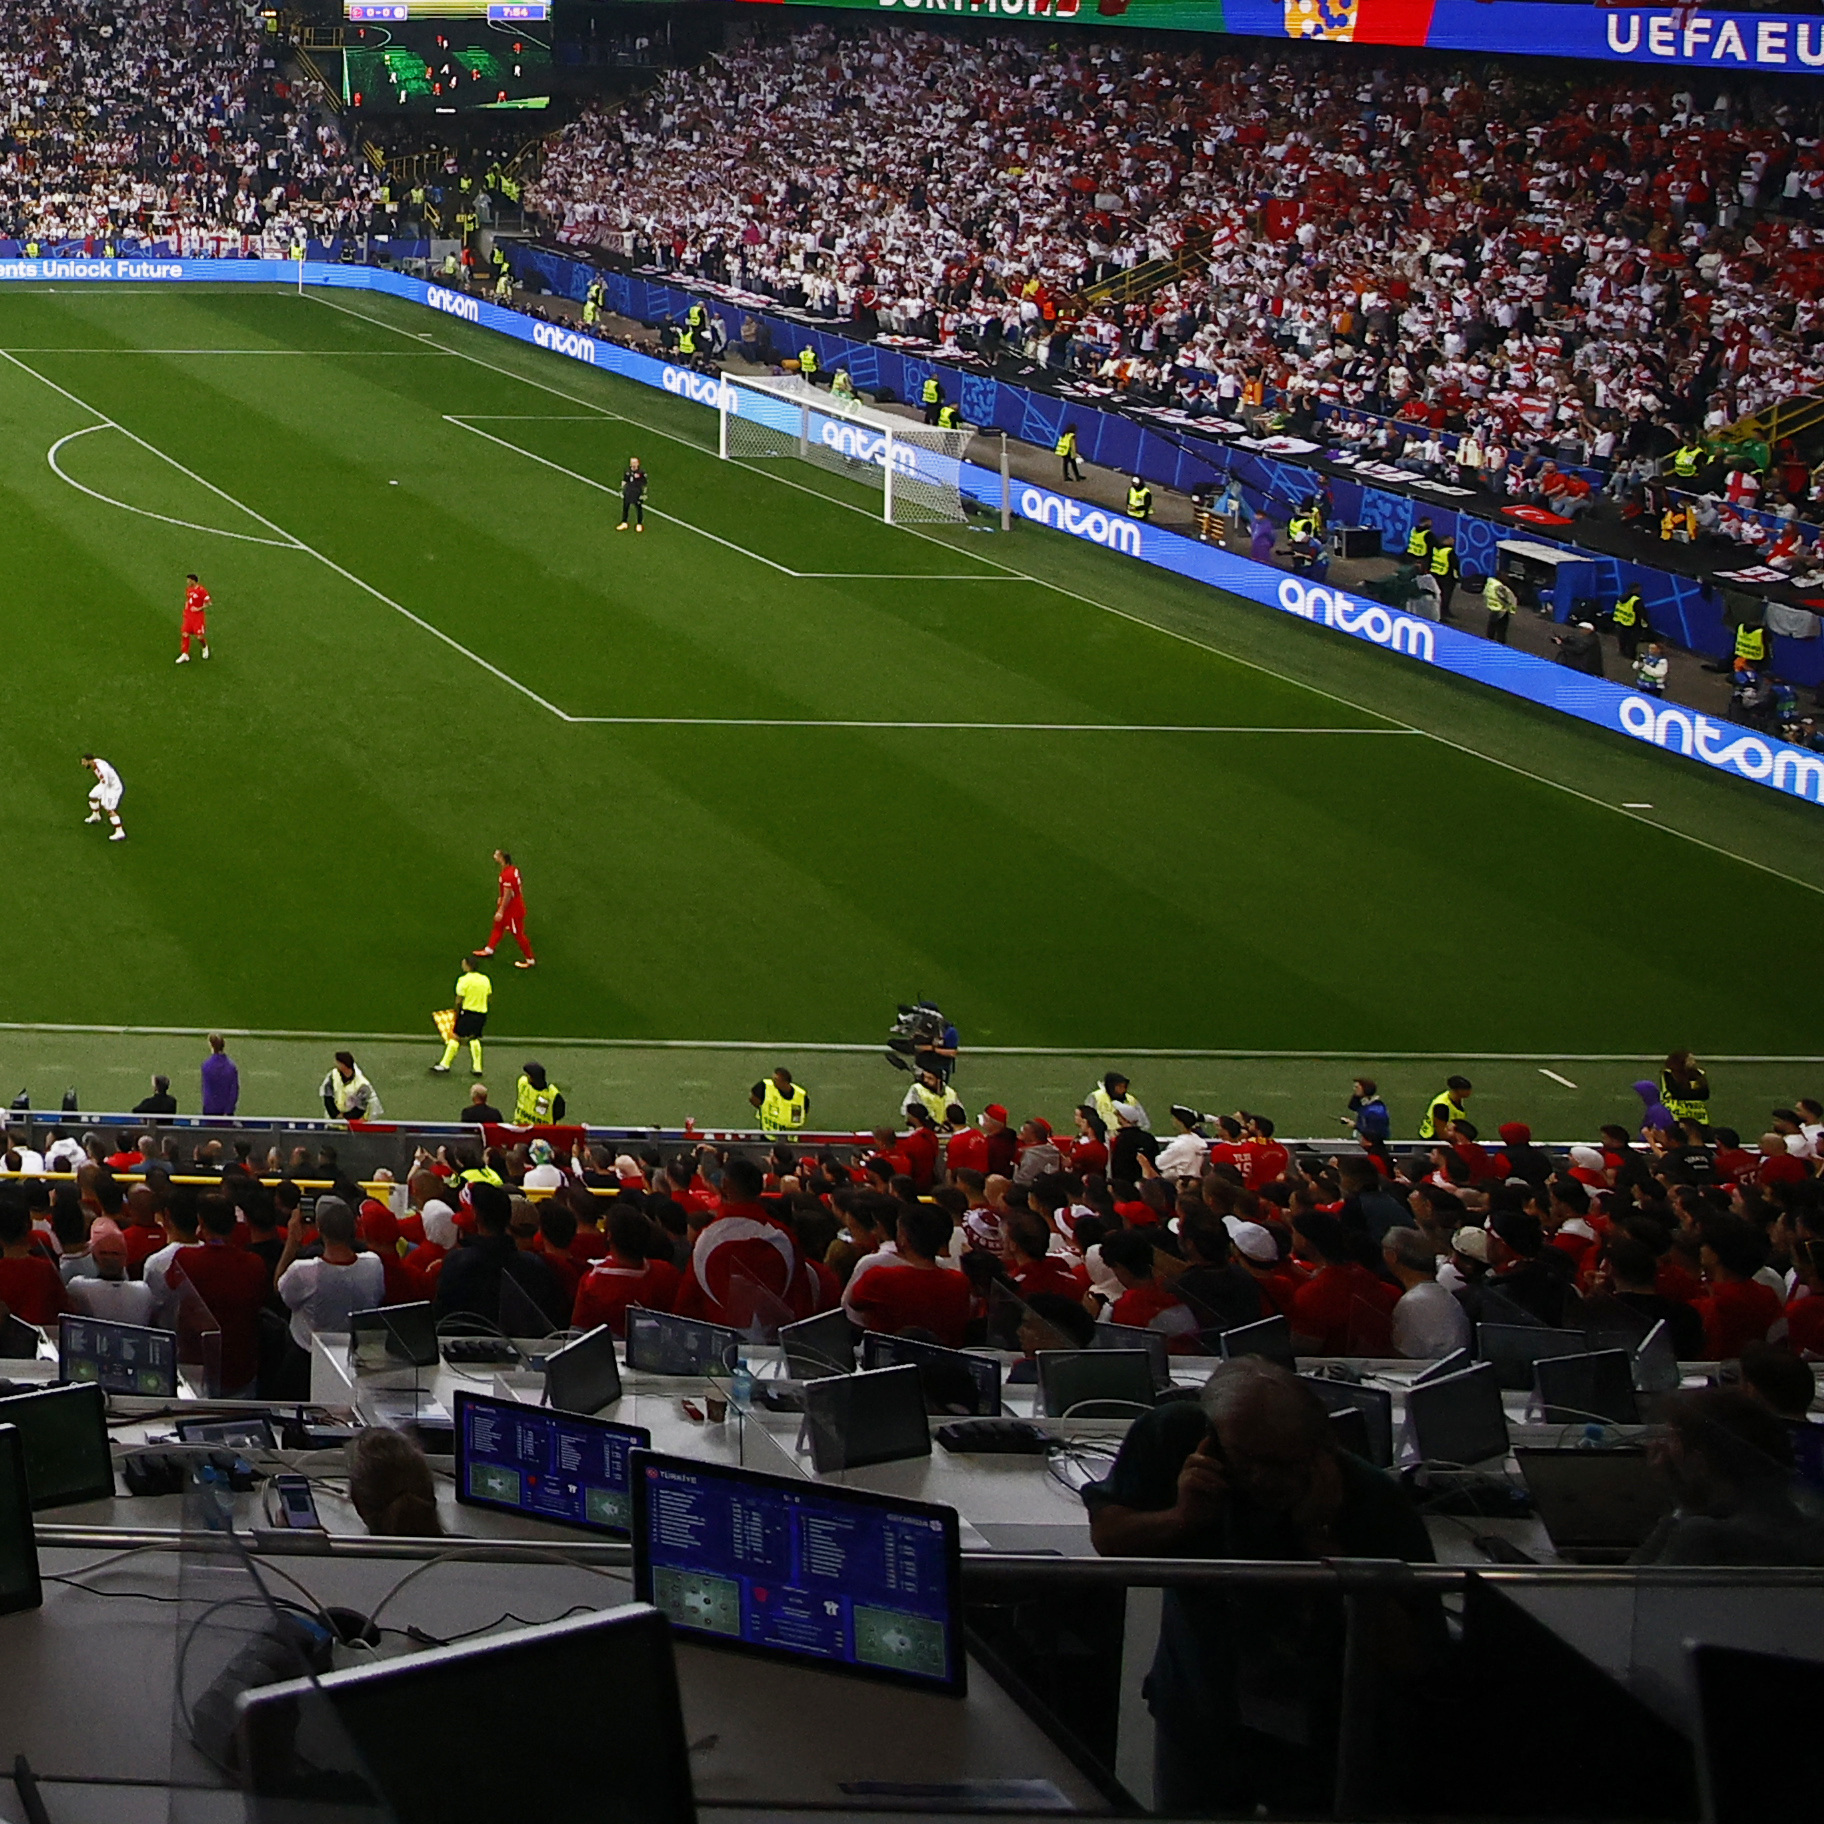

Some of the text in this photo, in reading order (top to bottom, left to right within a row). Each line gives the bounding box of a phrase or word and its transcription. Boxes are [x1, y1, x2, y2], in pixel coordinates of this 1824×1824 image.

[43, 261, 111, 278] Unlock
[118, 261, 183, 278] Future
[427, 286, 479, 322] antom
[533, 322, 595, 364] antom
[662, 366, 738, 415] antom
[821, 421, 916, 476] antom
[1021, 488, 1141, 557] antom
[1278, 578, 1435, 662] antom
